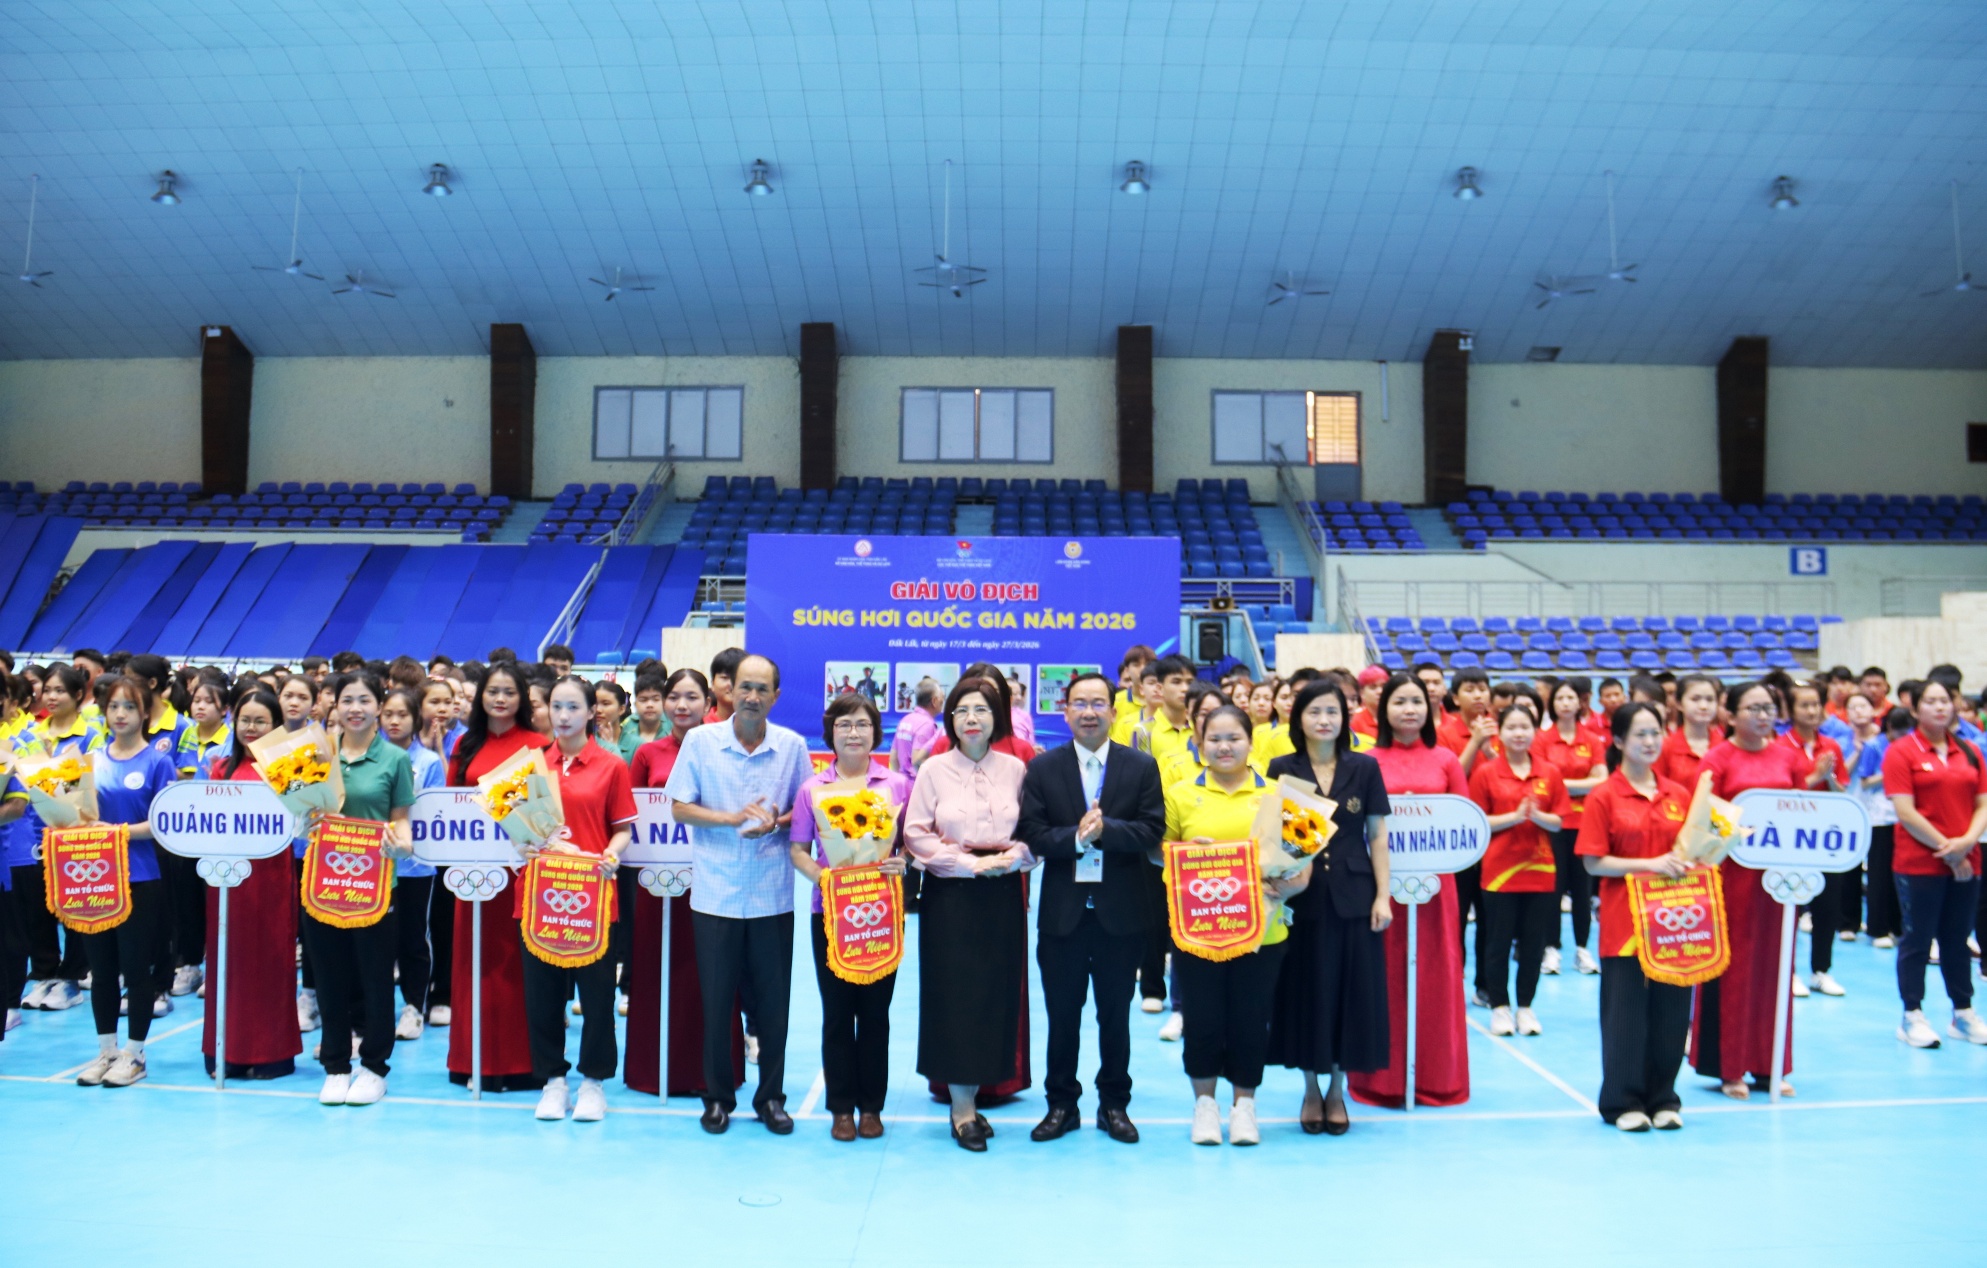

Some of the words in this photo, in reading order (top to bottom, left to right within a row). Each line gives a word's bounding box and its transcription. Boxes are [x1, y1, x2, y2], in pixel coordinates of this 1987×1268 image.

[1796, 549, 1822, 573] B
[890, 577, 939, 600] GIẢI
[943, 579, 976, 601] VÔ
[981, 582, 1038, 604] ĐỊCH
[792, 605, 855, 627] SÚNG
[860, 609, 900, 627] HƠI
[905, 604, 972, 628] QUỐC
[977, 611, 1018, 629] GIA
[1023, 607, 1075, 629] NĂM
[1080, 612, 1136, 630] 2026
[157, 804, 227, 835] QUẢNG
[233, 813, 284, 835] NINH
[411, 810, 485, 841] ĐỒNG
[1409, 826, 1446, 852] NHÂN
[1450, 824, 1477, 850] DÂN
[1795, 824, 1857, 858] NỘI
[844, 933, 860, 942] BAN
